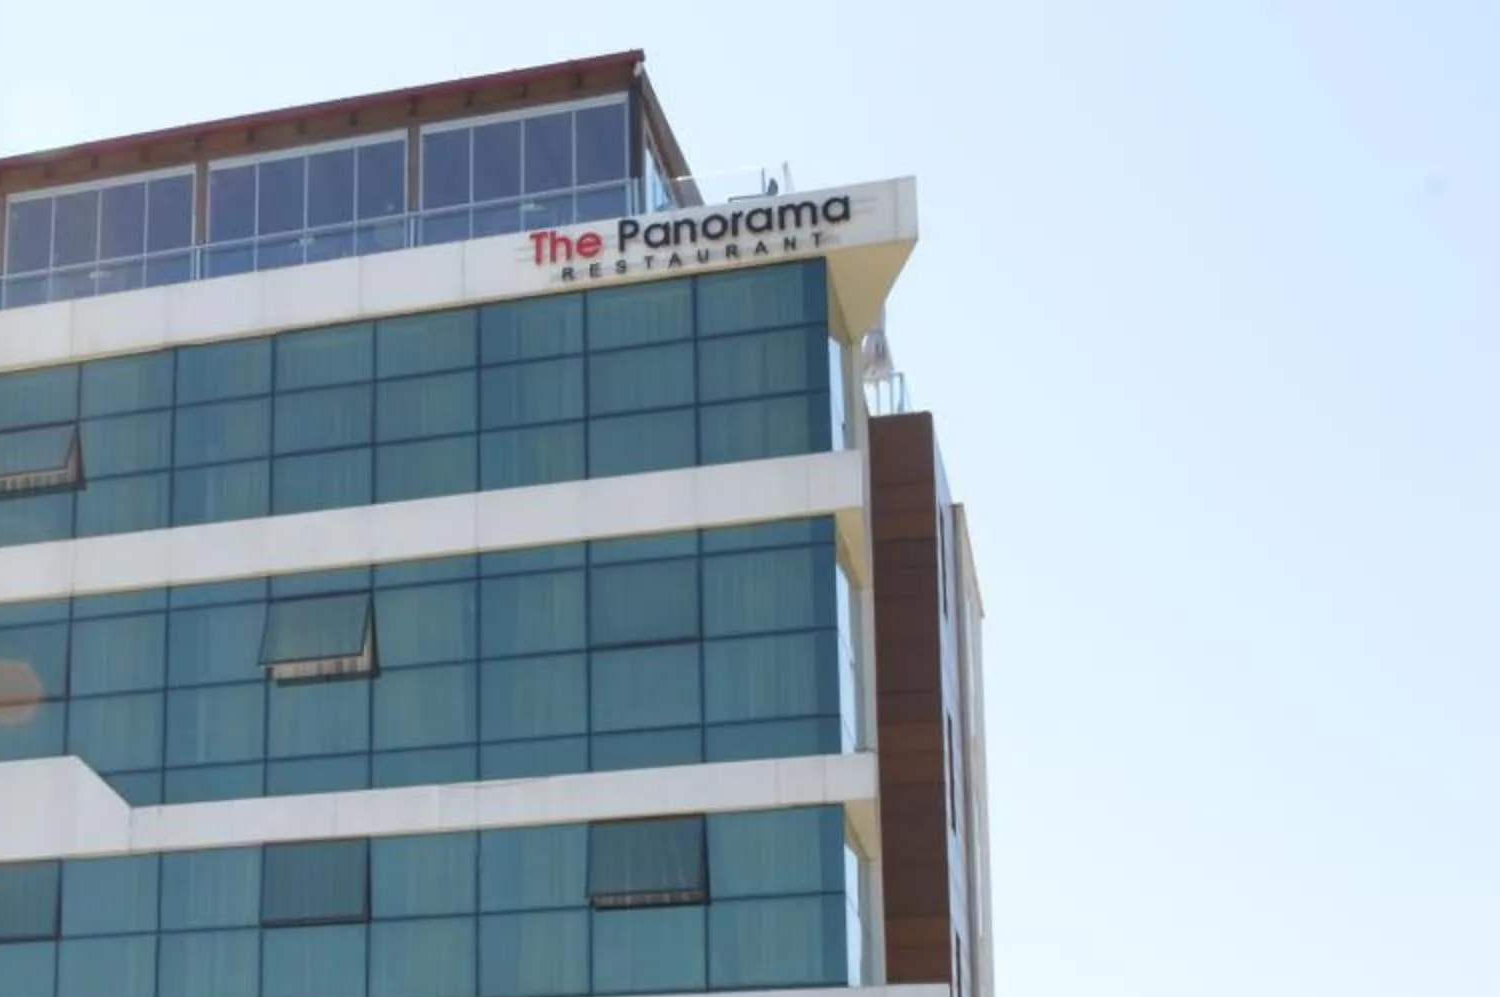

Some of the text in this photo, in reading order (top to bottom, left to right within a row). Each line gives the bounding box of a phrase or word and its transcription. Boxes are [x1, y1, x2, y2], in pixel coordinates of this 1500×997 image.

[529, 194, 851, 267] The Panorama
[561, 232, 826, 282] RESTAURANT
